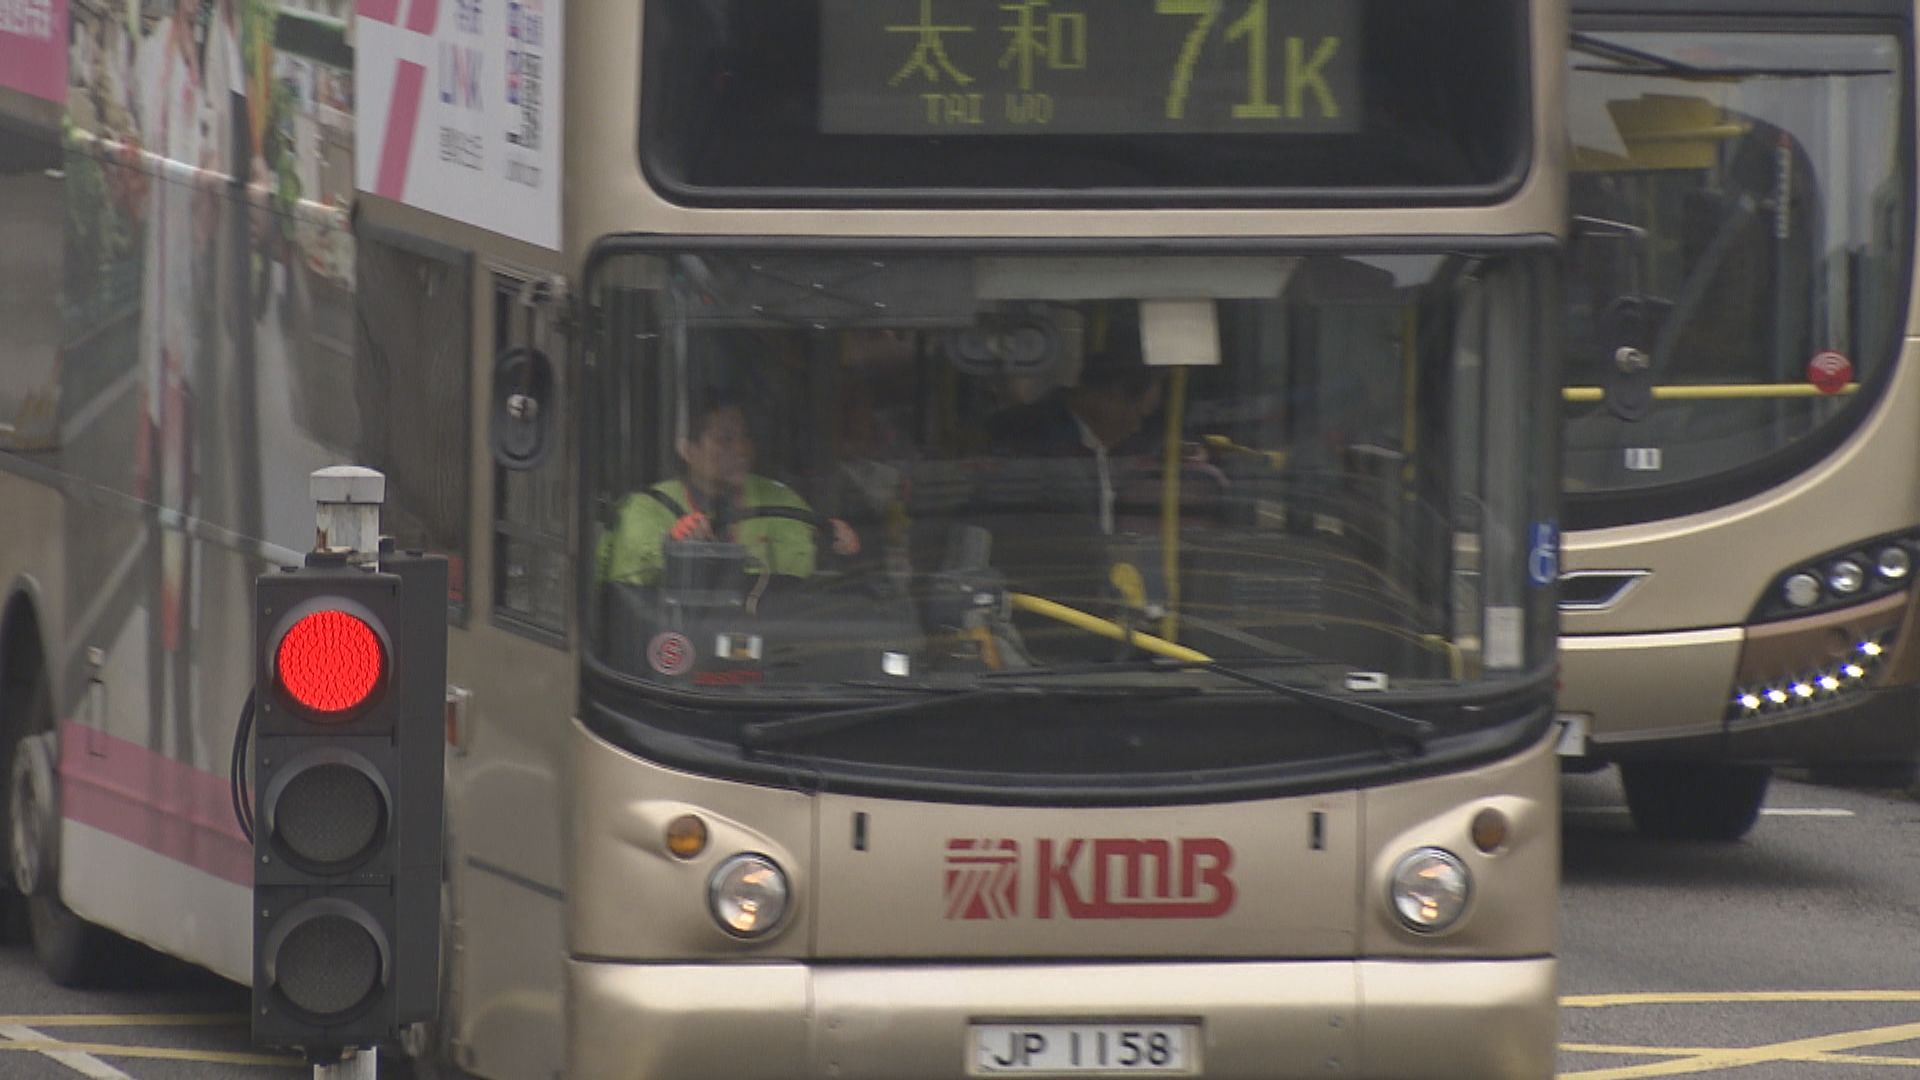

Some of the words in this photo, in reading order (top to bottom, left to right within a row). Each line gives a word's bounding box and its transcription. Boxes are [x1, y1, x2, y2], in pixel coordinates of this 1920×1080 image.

[884, 0, 1087, 91] 太和
[1154, 0, 1342, 119] 71K
[922, 93, 984, 123] TAI
[1005, 92, 1054, 124] WO
[1034, 837, 1238, 919] KMB
[992, 1031, 1047, 1067] JP
[1071, 1031, 1170, 1067] 1158
